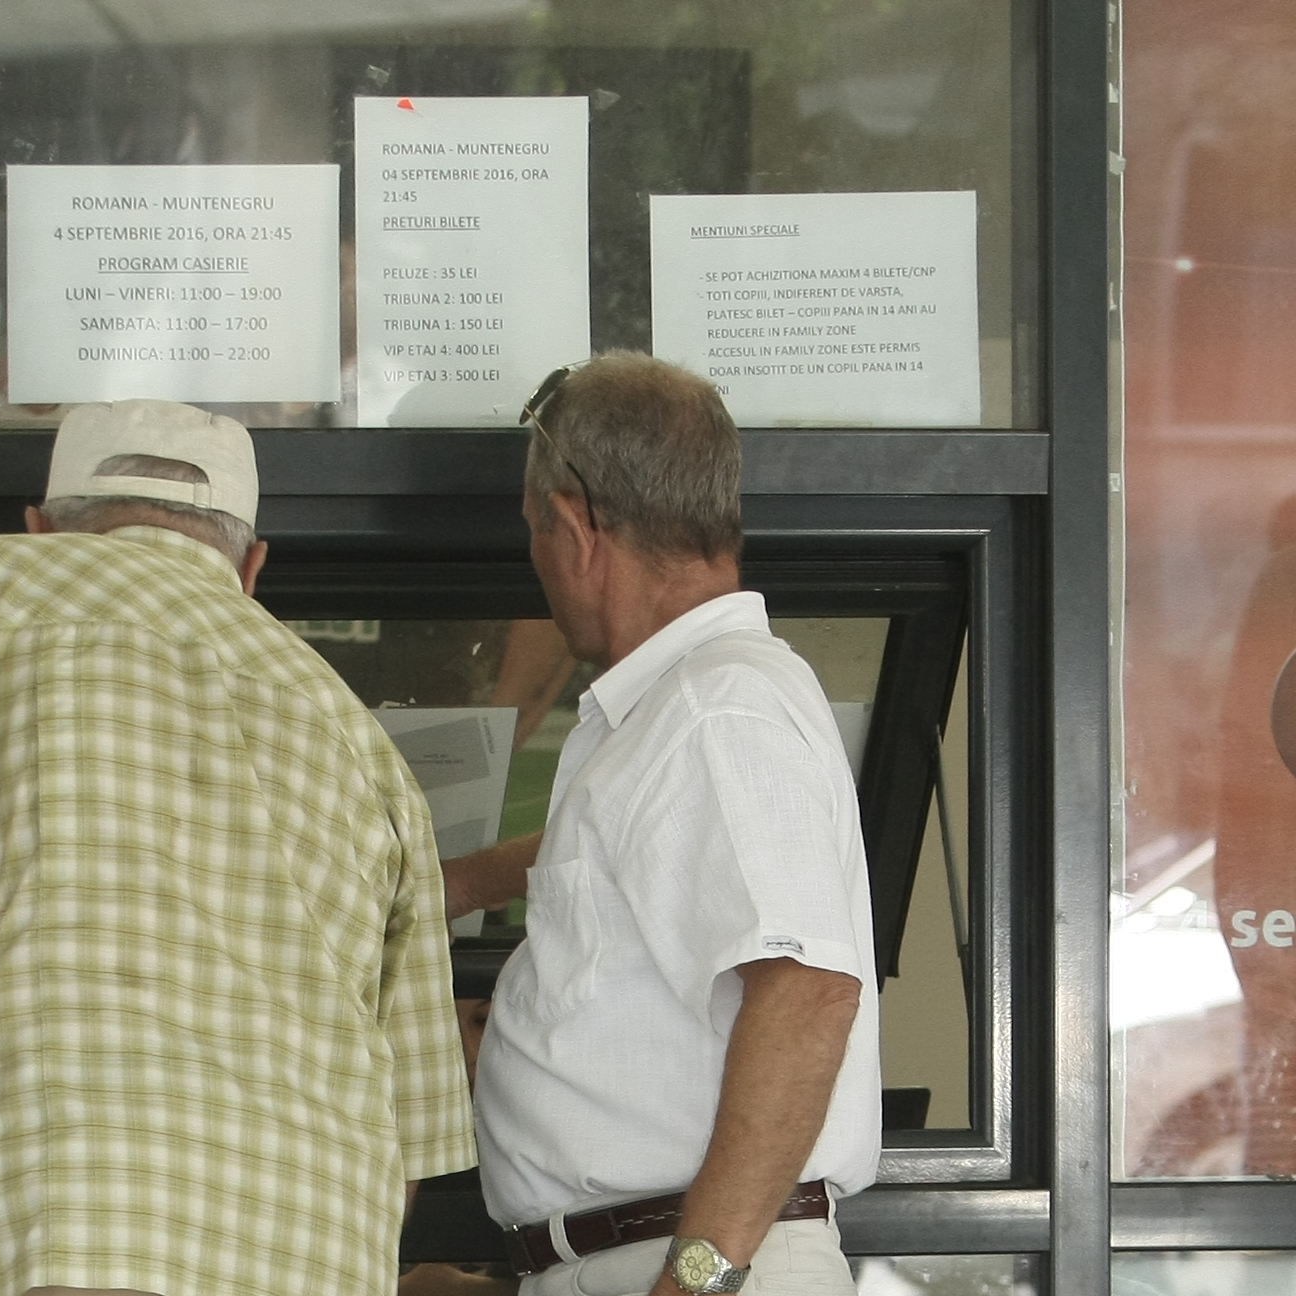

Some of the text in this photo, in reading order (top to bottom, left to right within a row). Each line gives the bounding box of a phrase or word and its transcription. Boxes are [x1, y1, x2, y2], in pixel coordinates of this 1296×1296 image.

[382, 143, 550, 156] ROMANIA MUNTENEGRU
[382, 169, 549, 183] 04 SEPTEMBRIE 2016, ORA
[382, 191, 418, 203] 21:45
[71, 197, 275, 211] ROMANIA MUNTENEGRU
[382, 216, 481, 228] PRETURI BILETE
[53, 228, 293, 243] 4 SEPTEMBRIE 2016, ORA 21:45
[690, 224, 800, 237] MENTIUNI SPECIALE
[98, 258, 249, 271] PROGRAM CASIERIE
[383, 268, 478, 280] PELUZE 35 LEI
[705, 265, 937, 283] SE POT ACHIZITIONA MAXIM 4 BILETE/CNP
[65, 288, 282, 301] LUNI VINERI: 11:00 19:00
[384, 293, 504, 305] TRIBUNA 2: 100 LEI
[706, 286, 904, 303] TOTI COPIII, INDIFERENT DE VARSTA,
[707, 304, 937, 320] PLATESC BILET COPIII PANA IN 14 ANI AU
[80, 317, 268, 331] SAMBATA: 11:00 17:00
[384, 319, 504, 331] TRIBUNA 1: 150 LEI
[707, 325, 857, 340] REDUCERE IN FAMILY ZONE
[77, 347, 271, 361] DUMINICA: 11:00 22:00
[384, 344, 500, 356] VIP ETAJ 4: 400 LEI
[708, 342, 921, 358] ACCESUL IN FAMILY ZONE ESTE PERMIS
[709, 360, 924, 378] DOAR INSOTIT DE UN COPIL PANA IN 14
[384, 370, 500, 382] VIP ETAJ 3: 500 LEI
